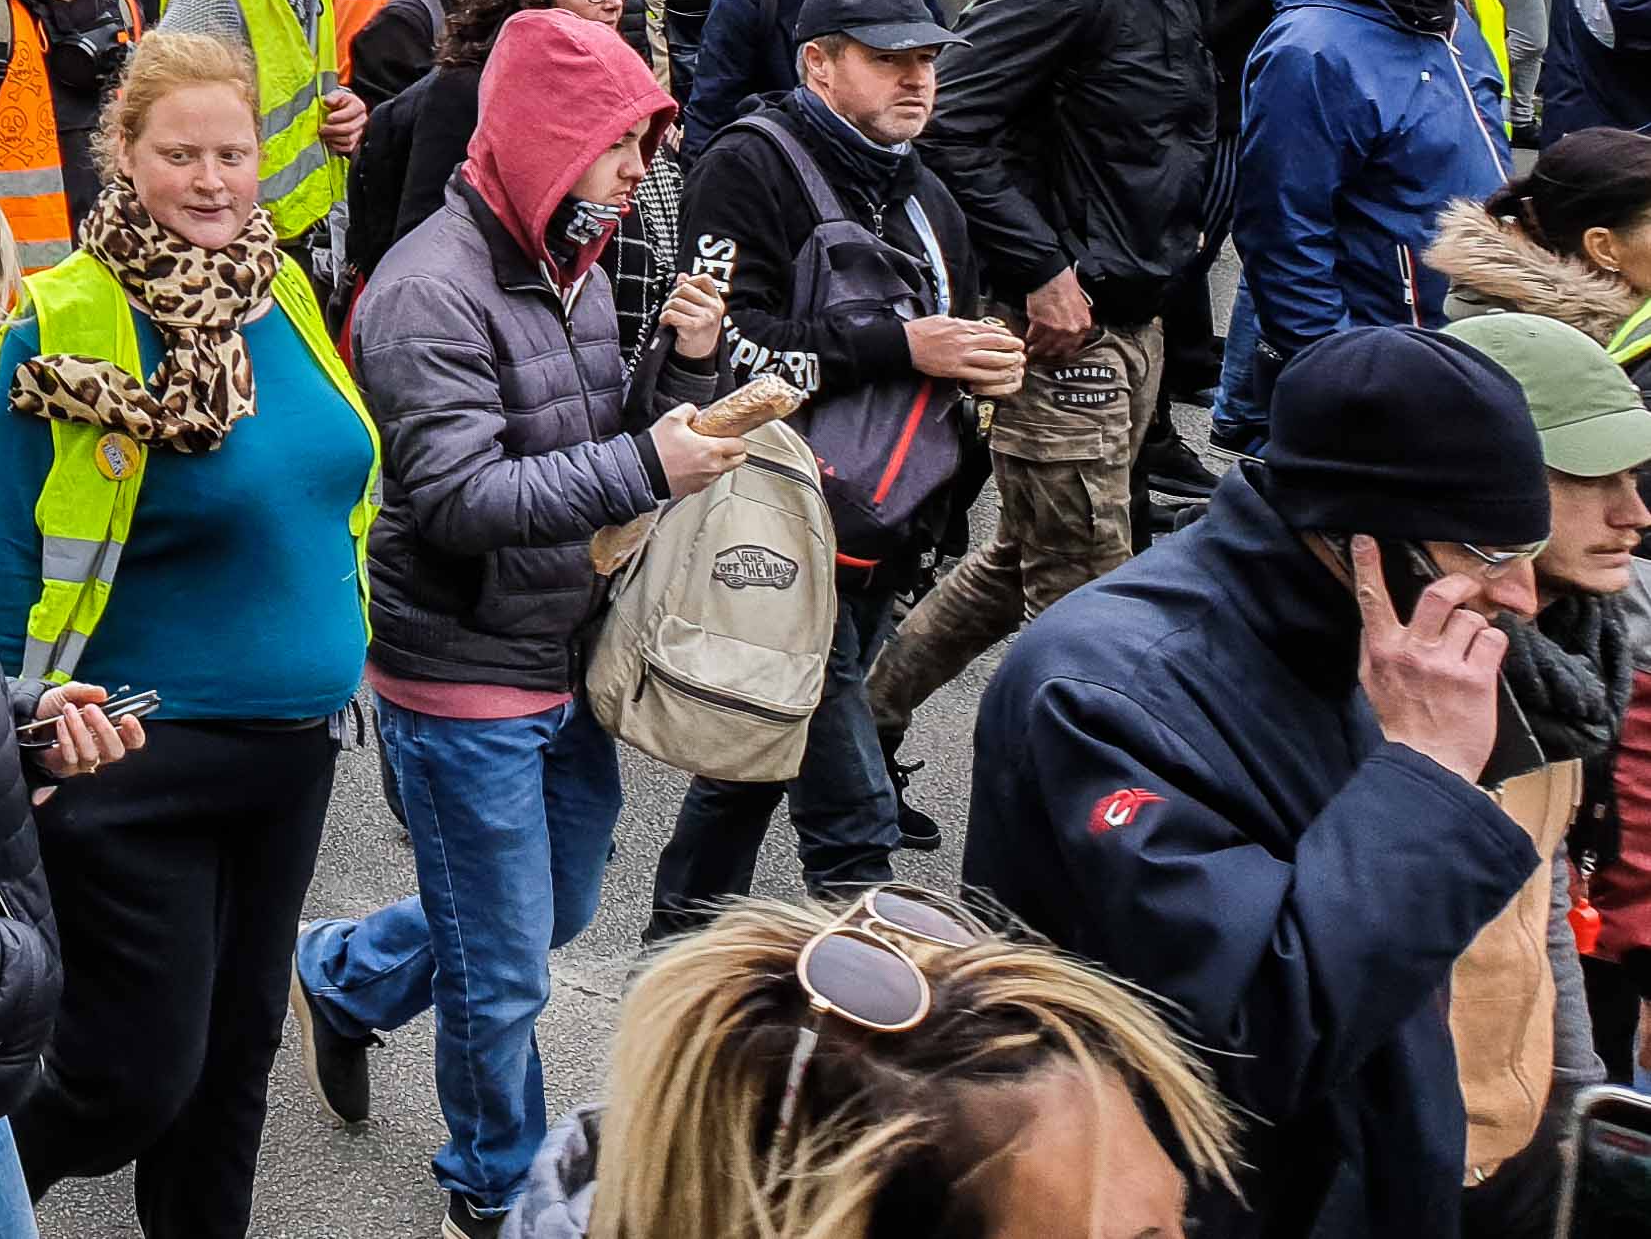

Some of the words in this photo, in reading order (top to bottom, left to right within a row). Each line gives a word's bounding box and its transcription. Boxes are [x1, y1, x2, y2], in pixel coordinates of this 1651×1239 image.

[1055, 367, 1112, 380] KAPORAL
[734, 549, 766, 564] VANS
[742, 562, 764, 578] THE
